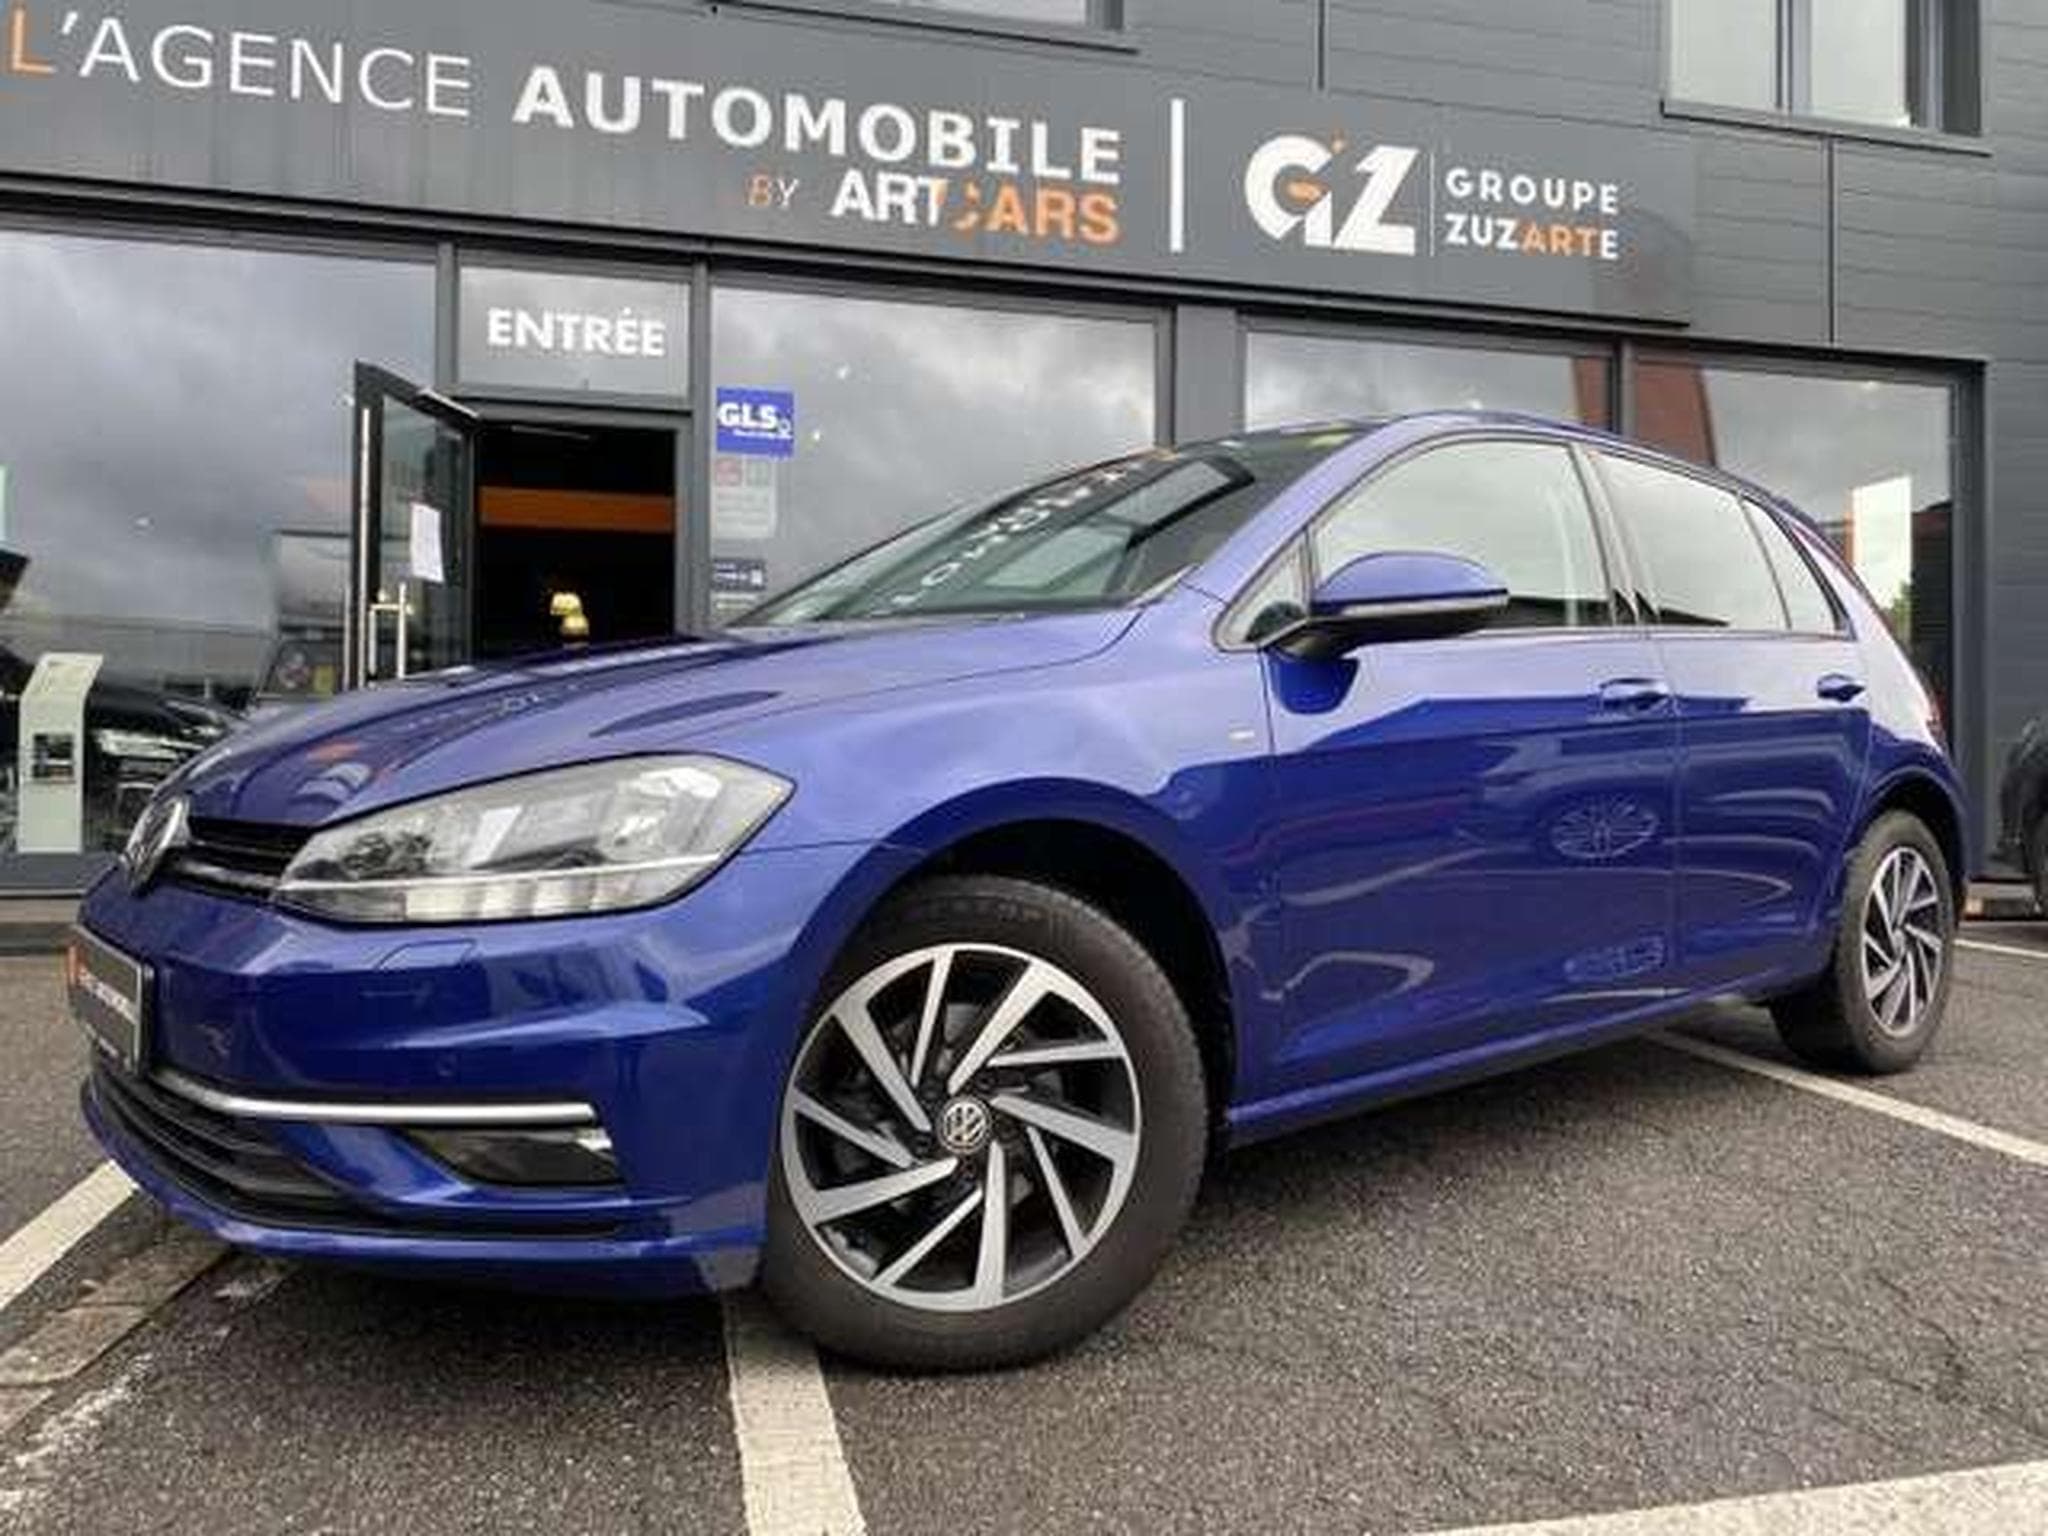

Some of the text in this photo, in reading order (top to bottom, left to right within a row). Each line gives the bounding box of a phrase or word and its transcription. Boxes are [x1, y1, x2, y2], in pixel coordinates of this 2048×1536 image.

[8, 3, 1122, 184] L'AGENCE AUTOMOBILE
[746, 173, 799, 209] BY
[1445, 167, 1619, 215] GROUPE
[1445, 213, 1619, 260] ZUZARTE
[487, 306, 665, 356] ENTRÉE
[718, 402, 777, 430] GLS
